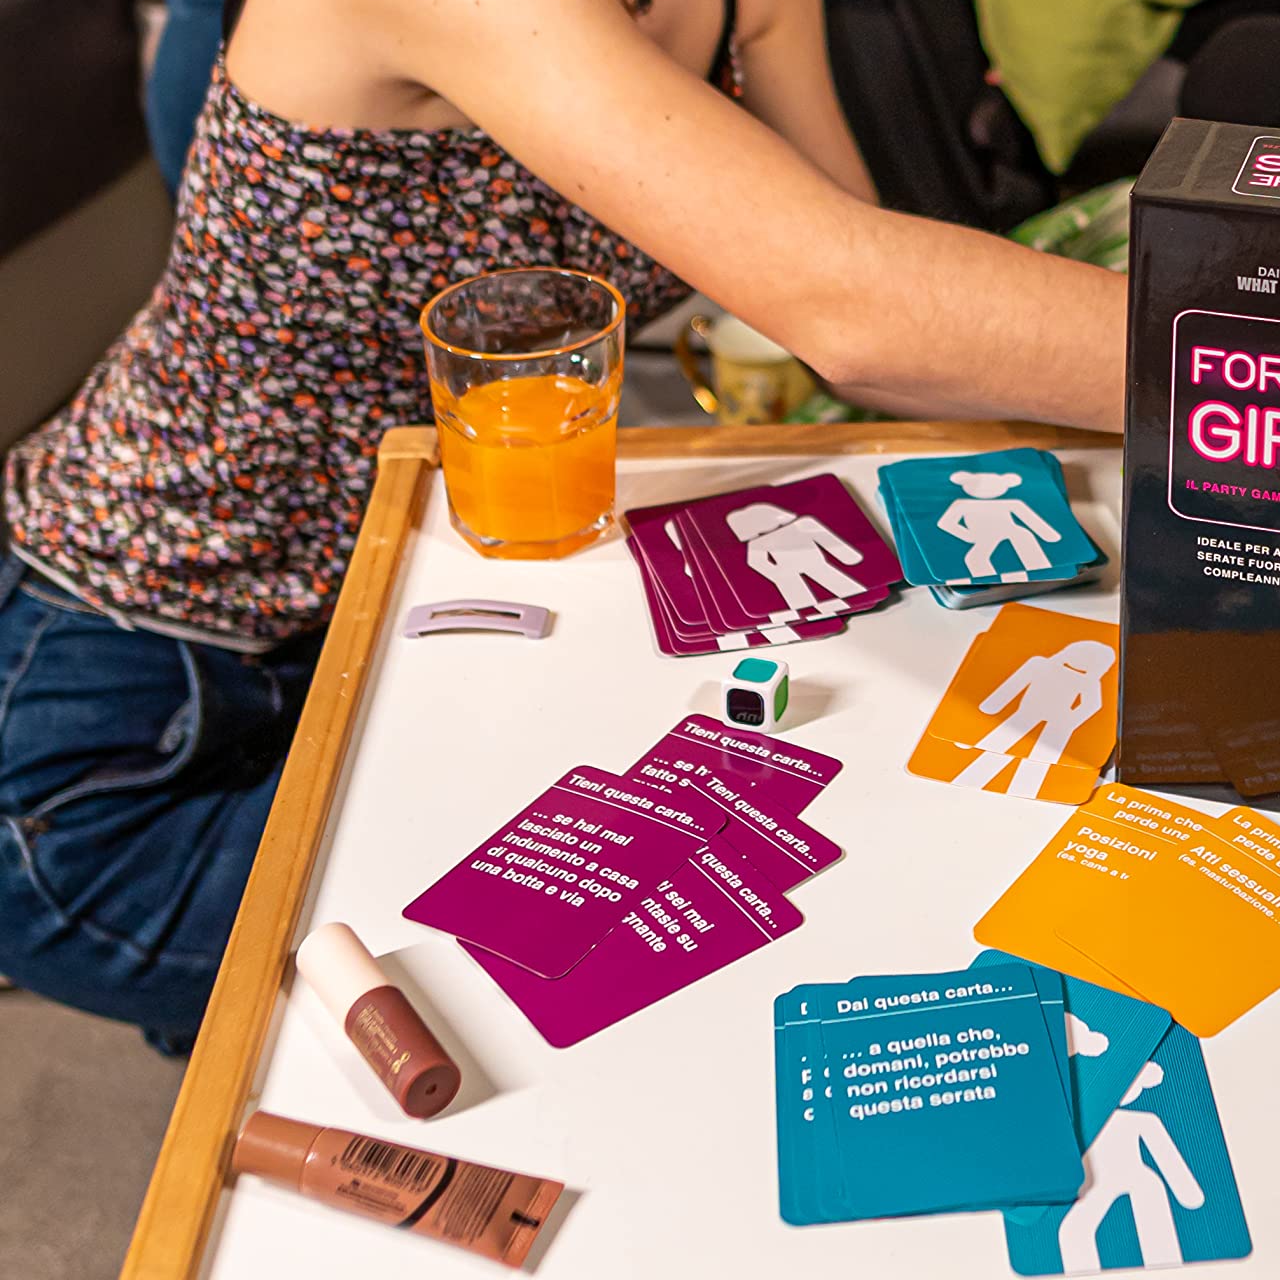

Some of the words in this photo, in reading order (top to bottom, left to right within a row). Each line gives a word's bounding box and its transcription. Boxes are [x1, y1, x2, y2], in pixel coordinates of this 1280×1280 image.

[1237, 276, 1278, 294] WHAT
[1258, 266, 1280, 278] DAI
[1186, 479, 1199, 490] IL
[1203, 482, 1248, 497] PARTY
[1196, 536, 1241, 551] IDEALE
[1245, 542, 1270, 555] PER
[1196, 551, 1245, 566] SERATE
[684, 722, 721, 740] Tieni
[720, 736, 771, 757] questa
[772, 753, 822, 777] carta...
[640, 764, 678, 782] fatto
[673, 760, 694, 771] se
[569, 774, 606, 792] Tieni
[604, 788, 654, 809] questa
[654, 805, 704, 831] carta...
[1107, 792, 1126, 804] La
[1127, 801, 1172, 820] prima
[1174, 817, 1204, 831] che
[552, 814, 573, 825] se
[573, 819, 603, 834] hai
[599, 830, 634, 846] mai
[706, 777, 740, 801] Tieni
[735, 800, 778, 831] questa
[776, 829, 817, 862] carta...
[1114, 810, 1159, 829] perde
[1233, 815, 1252, 829] La
[518, 819, 579, 845] lasciato
[579, 840, 602, 854] un
[1078, 827, 1157, 860] Posizioni
[1233, 835, 1275, 860] perde
[502, 832, 585, 866] indumento
[585, 862, 599, 872] a
[599, 868, 639, 889] casa
[1057, 851, 1077, 861] (es.
[1080, 860, 1108, 872] cane
[1064, 841, 1108, 860] yoga
[1179, 854, 1198, 866] (es.
[1190, 846, 1222, 865] Atti
[471, 860, 503, 875] una
[502, 868, 545, 890] botta
[545, 886, 558, 895] e
[560, 890, 585, 907] via
[487, 846, 508, 857] di
[505, 853, 578, 883] qualcuno
[578, 879, 622, 902] dopo
[701, 851, 742, 888] questa
[739, 888, 777, 928] carta...
[665, 891, 692, 910] sei
[683, 909, 715, 933] mai
[676, 934, 698, 952] su
[837, 998, 868, 1013] Dai
[875, 991, 939, 1010] questa
[945, 984, 1012, 999] carta...
[870, 1044, 881, 1055] a
[887, 1033, 950, 1054] quella
[957, 1029, 1000, 1043] che,
[844, 1054, 929, 1078] domani,
[935, 1043, 1029, 1068] potrebbe
[847, 1082, 888, 1097] non
[895, 1064, 997, 1090] ricordarsi
[850, 1096, 923, 1120] questa
[930, 1086, 995, 1106] serata
